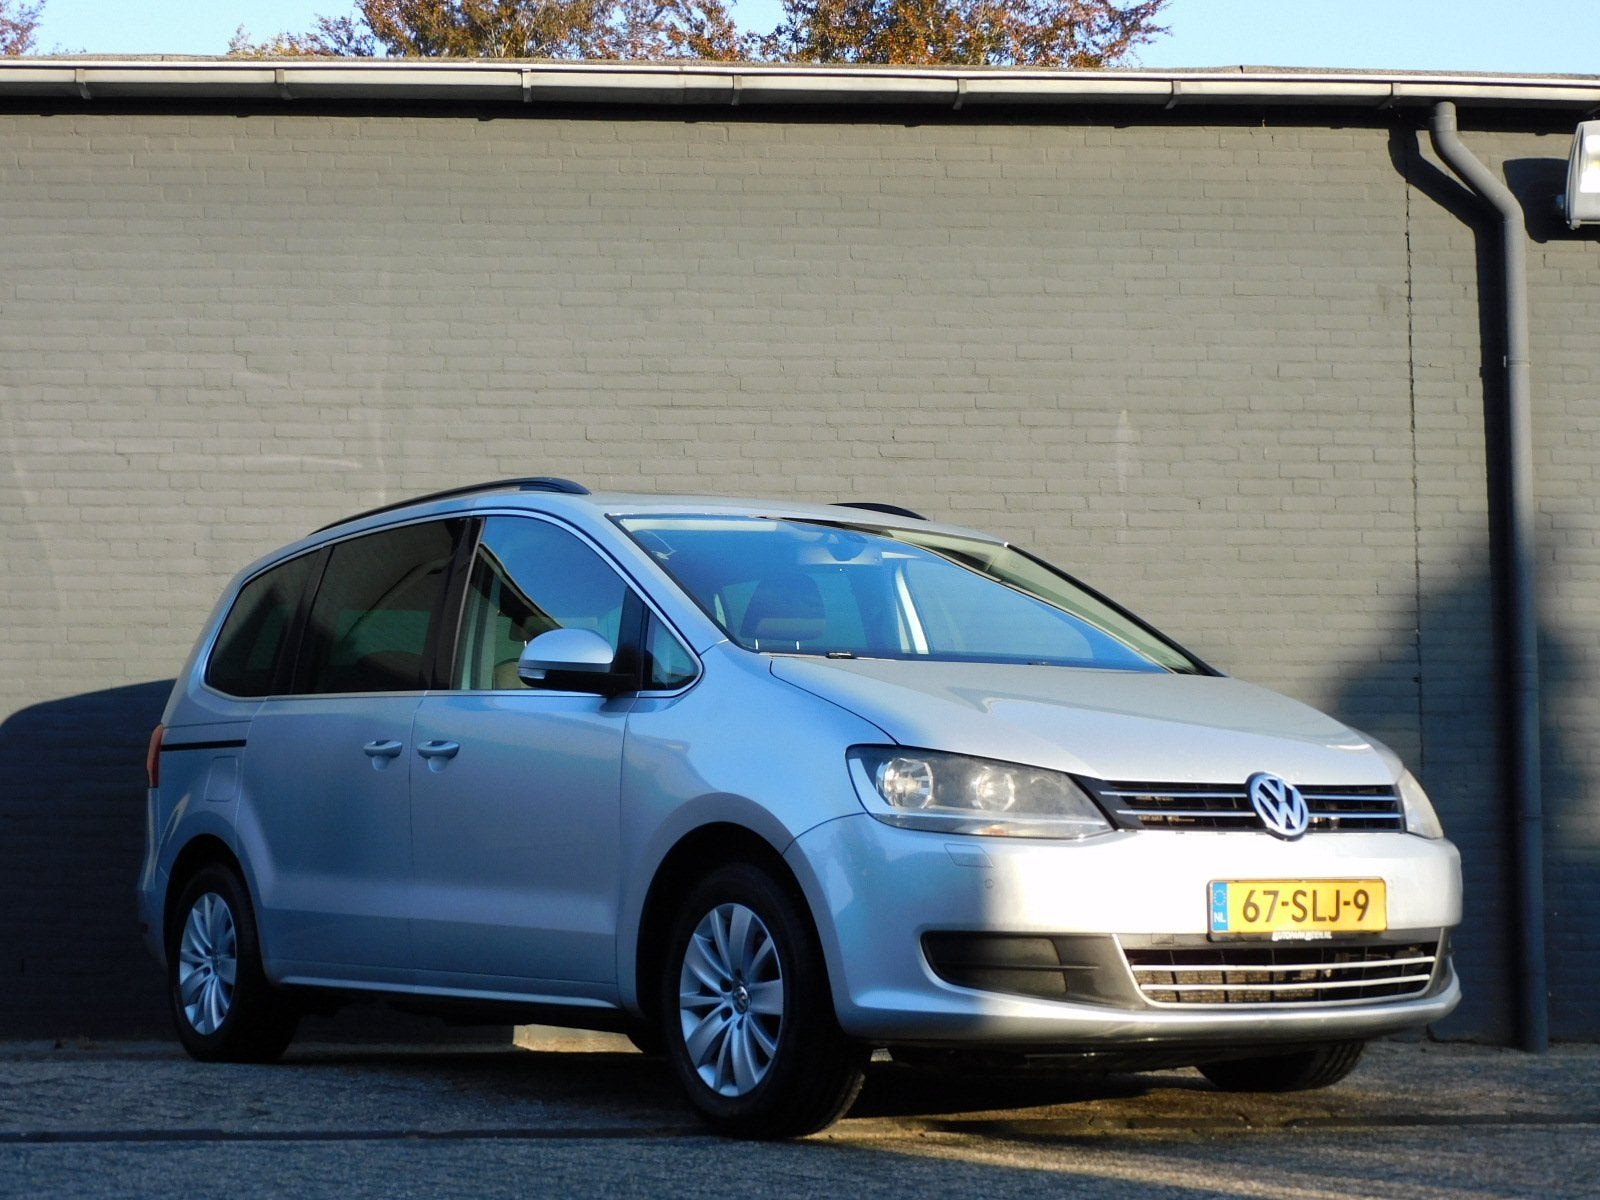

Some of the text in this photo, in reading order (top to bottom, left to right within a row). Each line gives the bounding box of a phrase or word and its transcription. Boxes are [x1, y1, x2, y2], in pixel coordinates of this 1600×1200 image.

[1251, 773, 1308, 835] VW
[1213, 912, 1226, 923] NL
[1242, 889, 1370, 923] 67-SLJ-9
